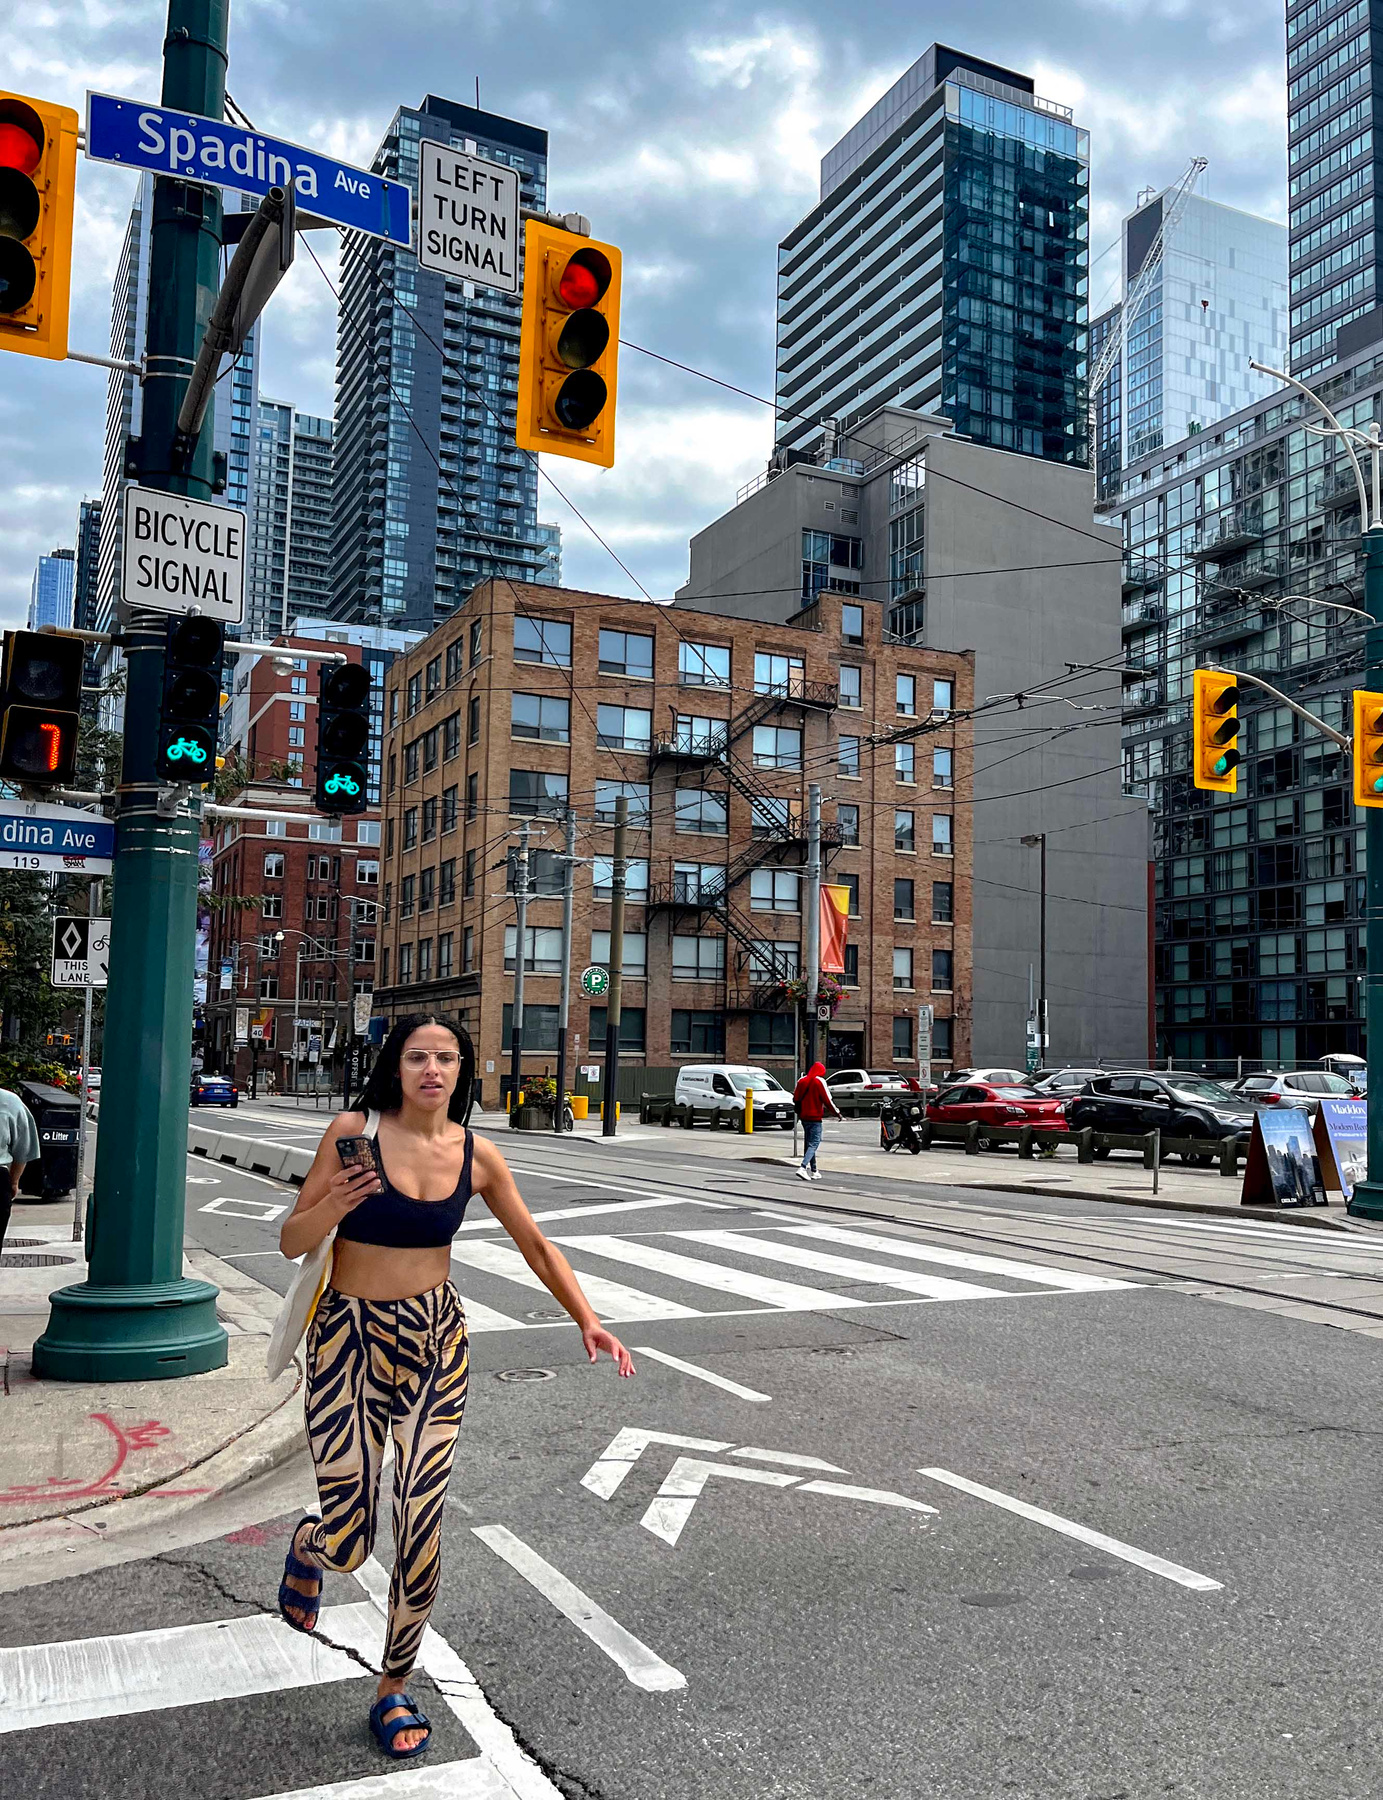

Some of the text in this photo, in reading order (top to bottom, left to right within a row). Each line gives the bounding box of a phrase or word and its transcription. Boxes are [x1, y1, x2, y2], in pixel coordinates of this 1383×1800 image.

[138, 113, 371, 199] Spadina Ave
[436, 158, 504, 201] LEFT
[433, 194, 506, 240] TURN
[427, 230, 511, 278] SIGNAL
[135, 506, 239, 560] BICYCLE
[136, 554, 233, 604] SIGNAL
[62, 828, 96, 848] Ave
[13, 856, 40, 869] 119
[60, 972, 90, 982] LANE
[63, 961, 88, 971] THIS
[252, 1029, 263, 1037] 40
[52, 1131, 69, 1141] Litter
